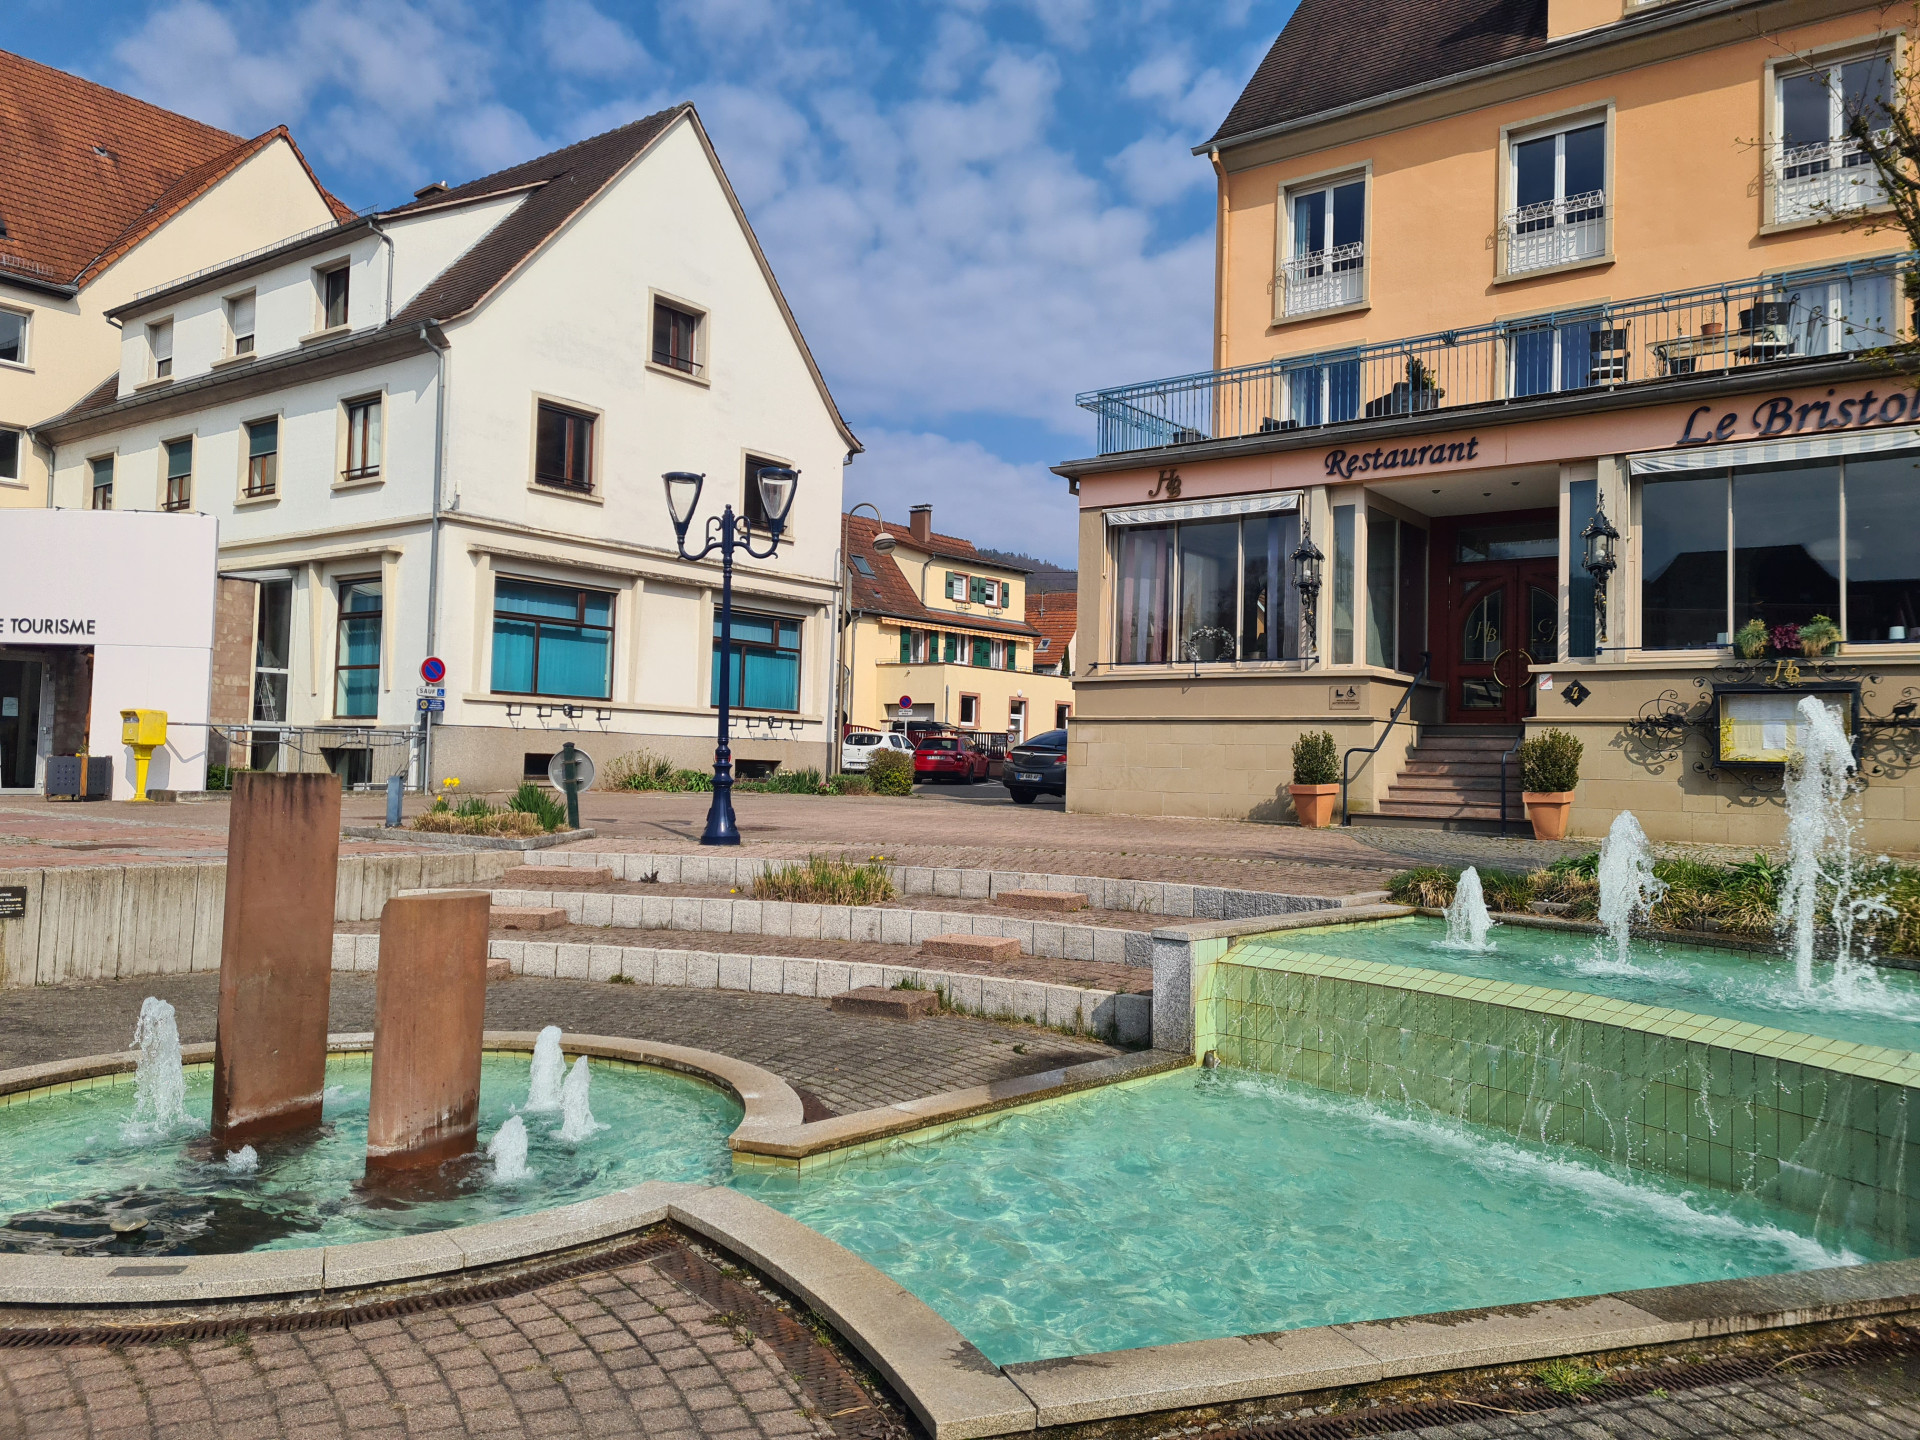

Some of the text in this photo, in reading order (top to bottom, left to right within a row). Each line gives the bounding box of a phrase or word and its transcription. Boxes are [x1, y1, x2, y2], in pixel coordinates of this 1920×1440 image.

[1676, 405, 1738, 445] Le
[1325, 436, 1479, 480] Restaurant
[10, 617, 96, 635] TOURISME
[419, 687, 436, 695] SAUF
[1570, 686, 1580, 700] 4
